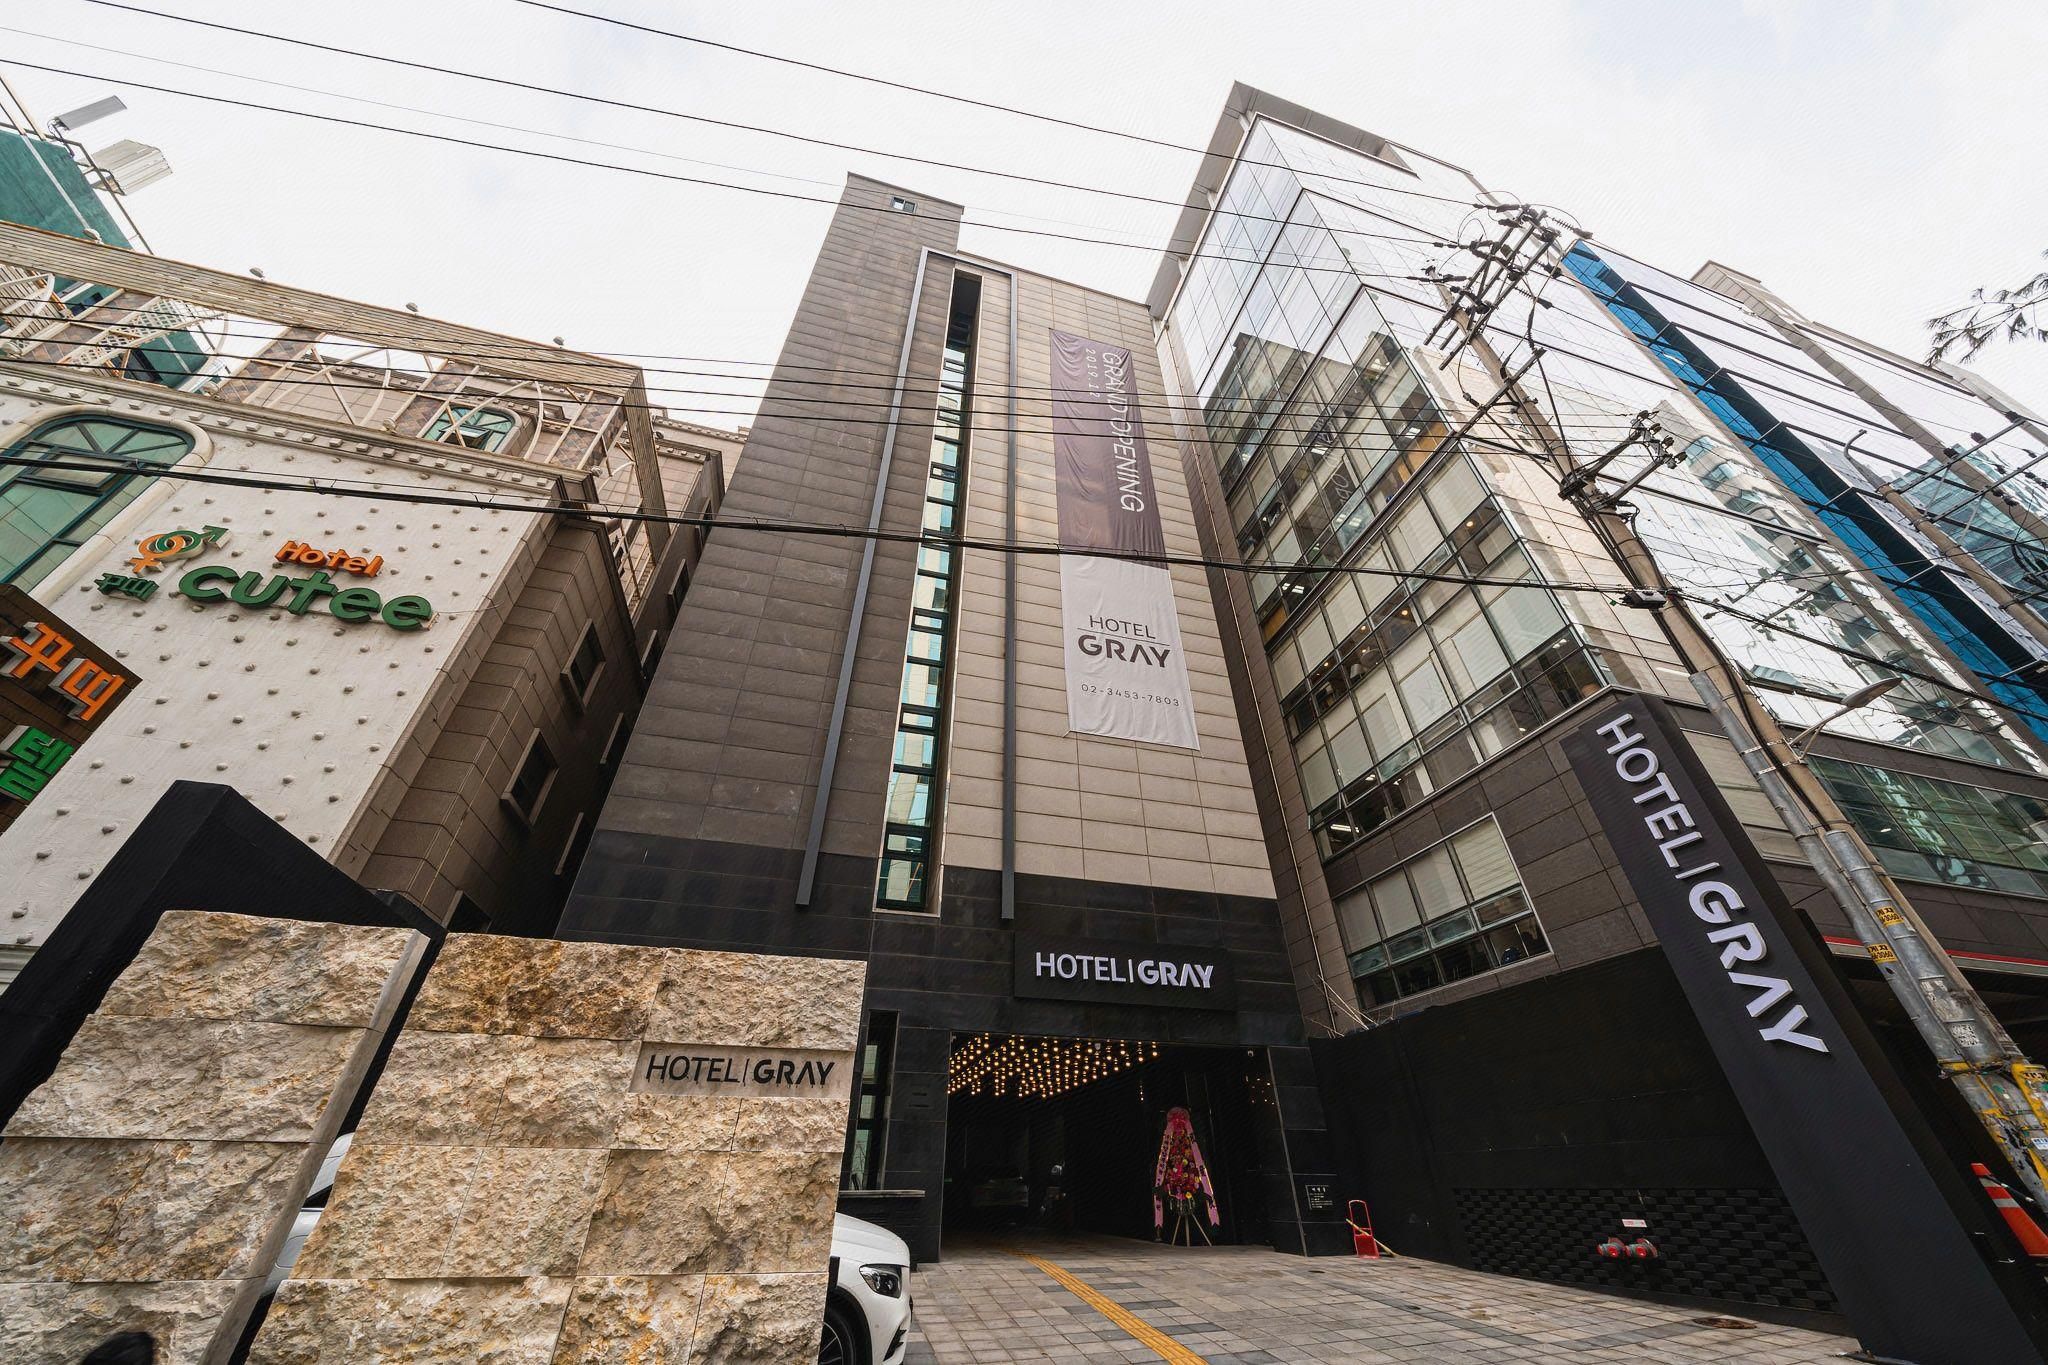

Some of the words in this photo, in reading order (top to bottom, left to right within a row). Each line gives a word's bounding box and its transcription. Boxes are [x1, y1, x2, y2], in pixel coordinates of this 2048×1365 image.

[1085, 348, 1101, 399] 2019.12
[1102, 352, 1129, 413] GRAND
[1109, 418, 1145, 513] OPENING
[275, 540, 384, 578] Hotel
[179, 565, 432, 631] cutee
[1089, 615, 1156, 640] HOTEL
[1078, 634, 1171, 668] GRAY
[1081, 683, 1180, 707] 02-3453-7803
[1596, 713, 1703, 868] HOTEL
[1688, 880, 1830, 1053] GRAY
[1035, 951, 1127, 983] HOTEL
[1137, 959, 1214, 989] GRAY
[645, 1053, 740, 1083] HOTEL
[753, 1058, 835, 1086] GRAY
